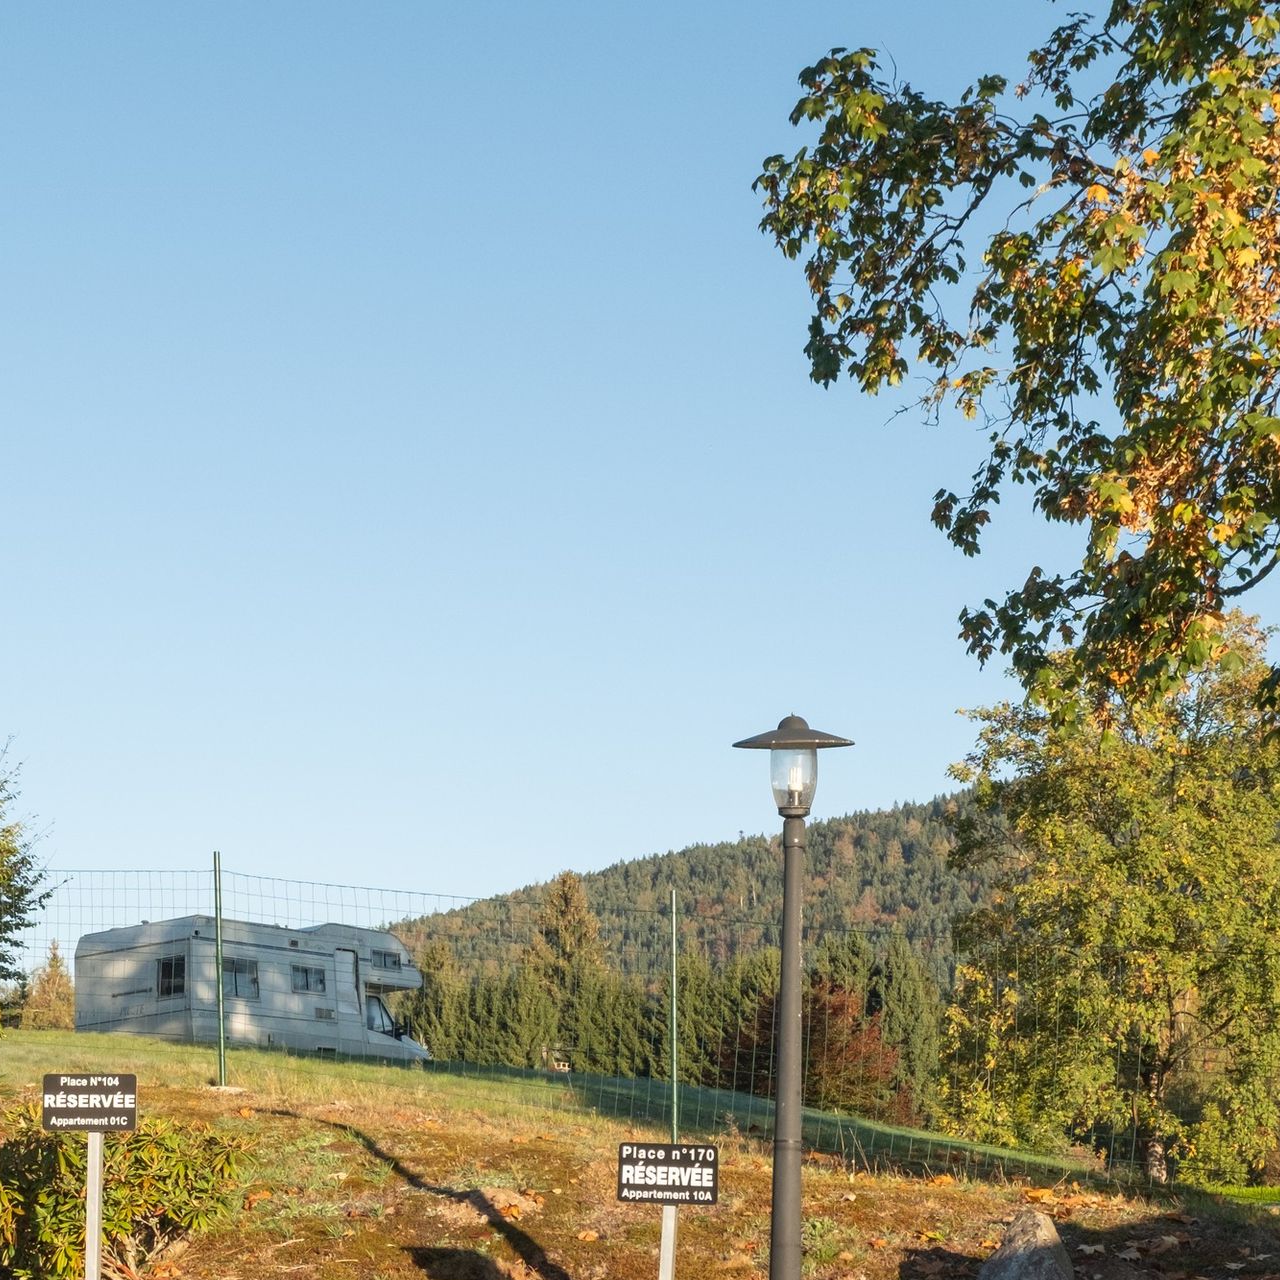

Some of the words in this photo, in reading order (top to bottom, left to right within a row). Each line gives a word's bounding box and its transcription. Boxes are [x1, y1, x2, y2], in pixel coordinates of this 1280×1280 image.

[60, 1076, 88, 1087] Place
[43, 1091, 136, 1109] RÉSERVÉE
[50, 1116, 109, 1127] Appartement
[109, 1116, 128, 1126] 01C
[622, 1145, 666, 1160] Place
[671, 1147, 715, 1161] n°170
[622, 1160, 714, 1187] RÉSERVÉE
[621, 1188, 690, 1200] Appartement
[692, 1191, 713, 1201] 10A
